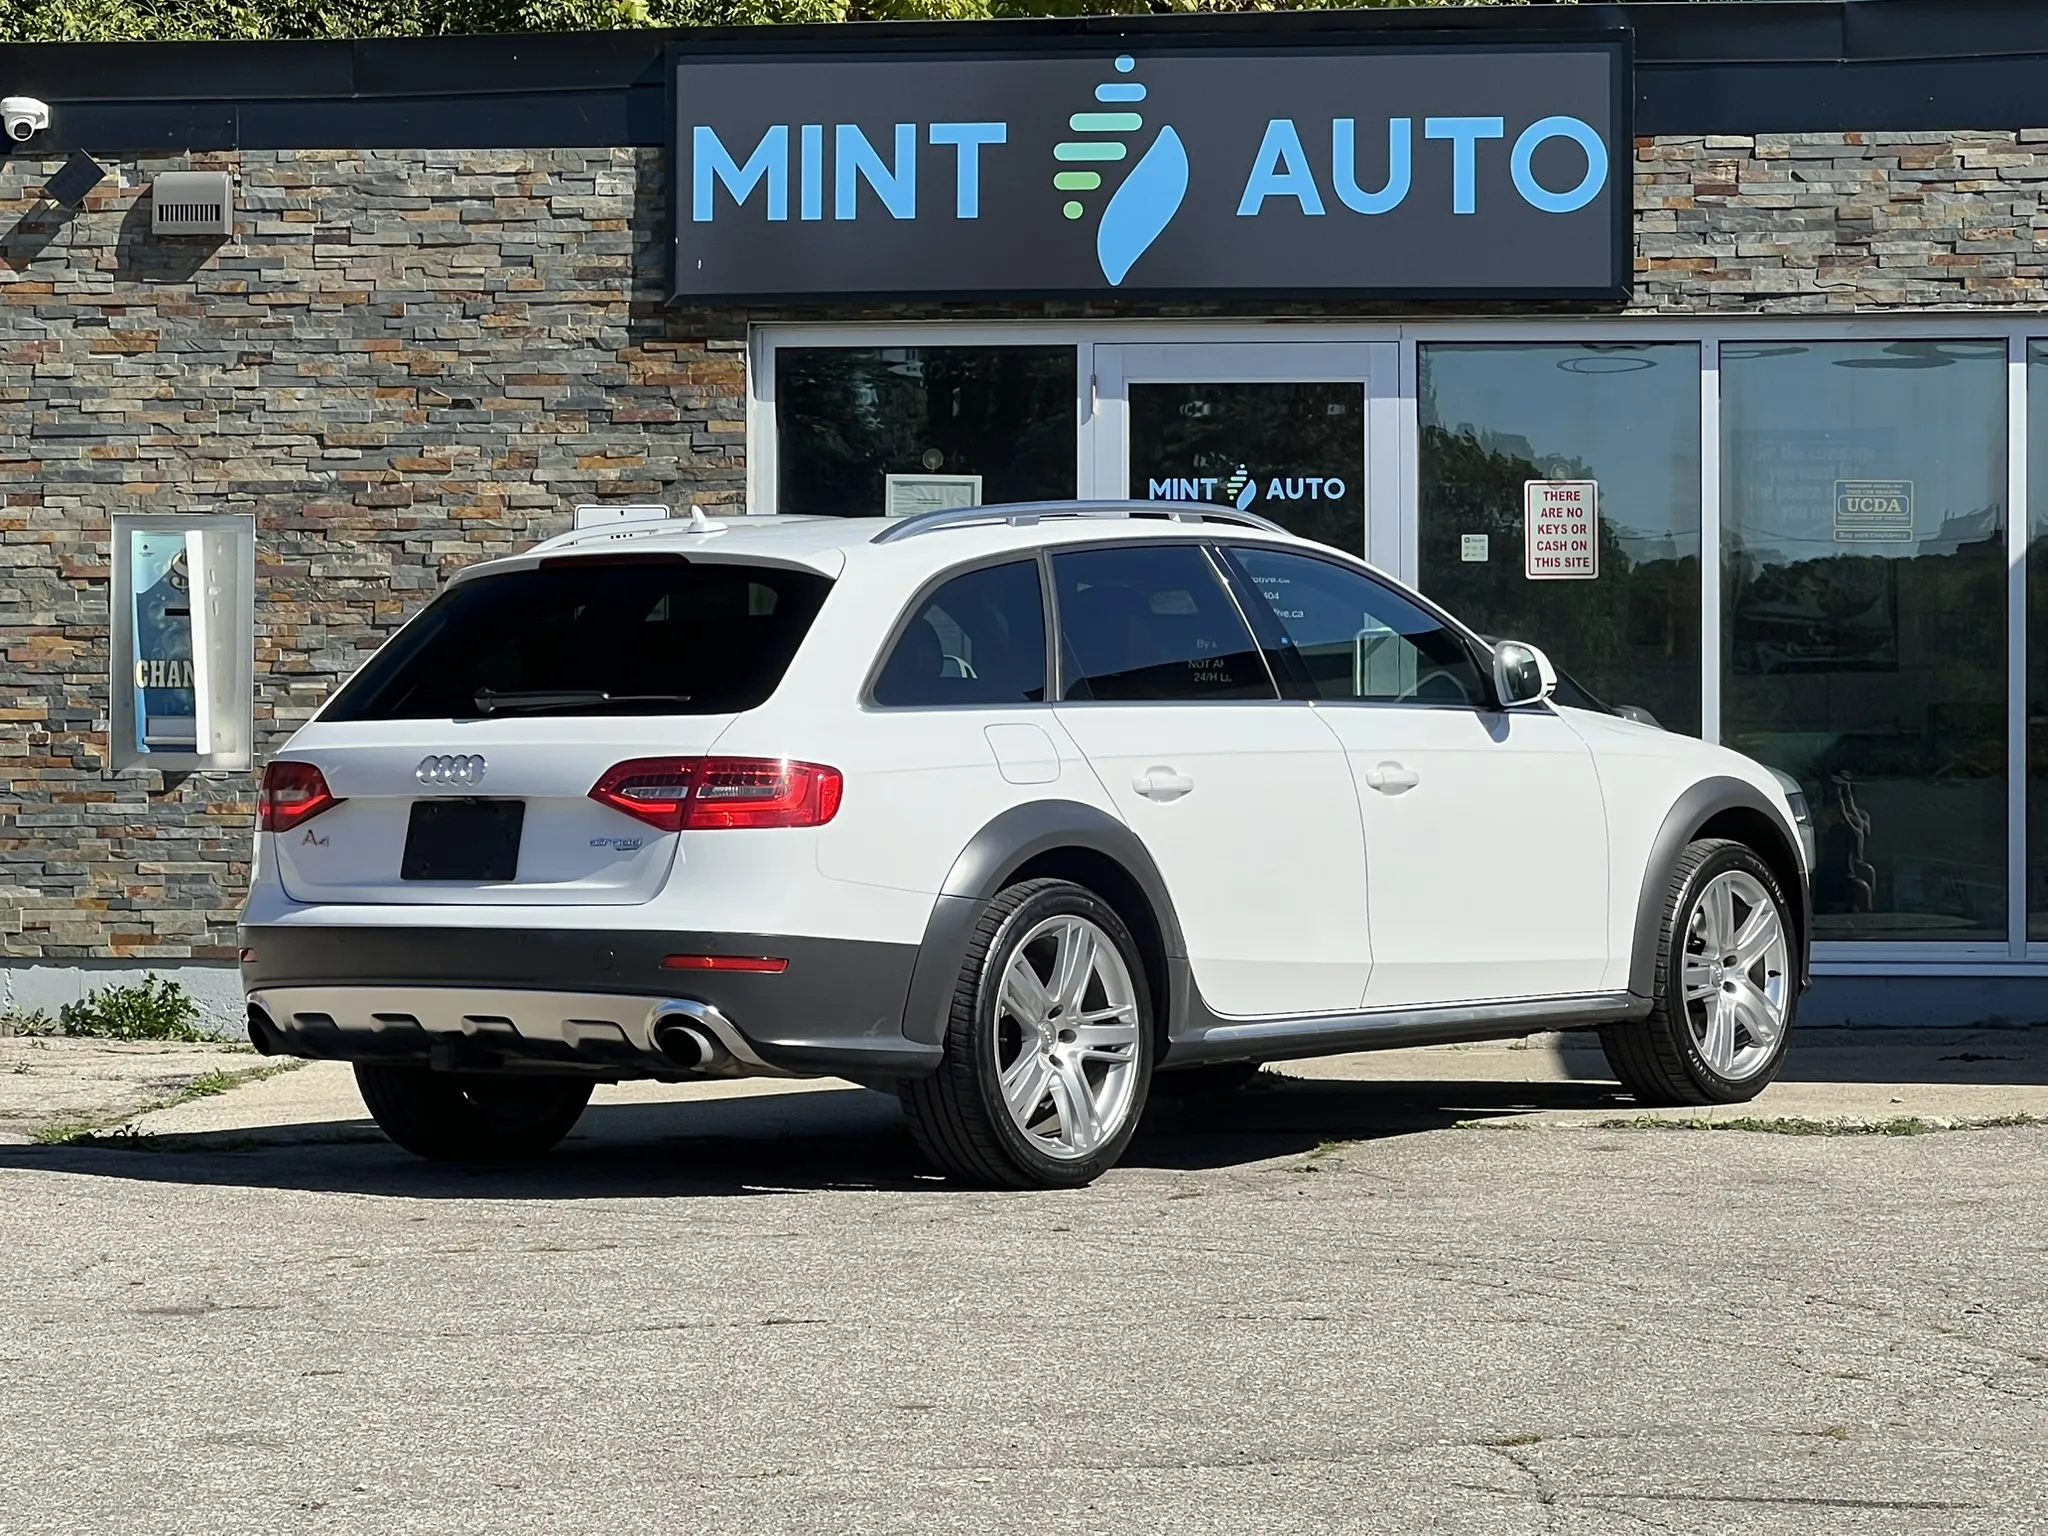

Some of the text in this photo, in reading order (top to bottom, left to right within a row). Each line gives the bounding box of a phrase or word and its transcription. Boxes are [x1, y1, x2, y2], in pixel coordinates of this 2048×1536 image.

[692, 115, 1609, 222] MINT AUTO
[1149, 477, 1346, 500] MINT AUTO
[1543, 490, 1581, 501] THERE
[1846, 498, 1902, 512] UCDA
[1540, 507, 1583, 518] ARE NO
[1537, 524, 1587, 535] KEYS OR
[1536, 540, 1588, 551] CASH ON
[1534, 557, 1590, 568] THIS SITE
[1188, 659, 1210, 669] NOT
[301, 828, 330, 848] A4
